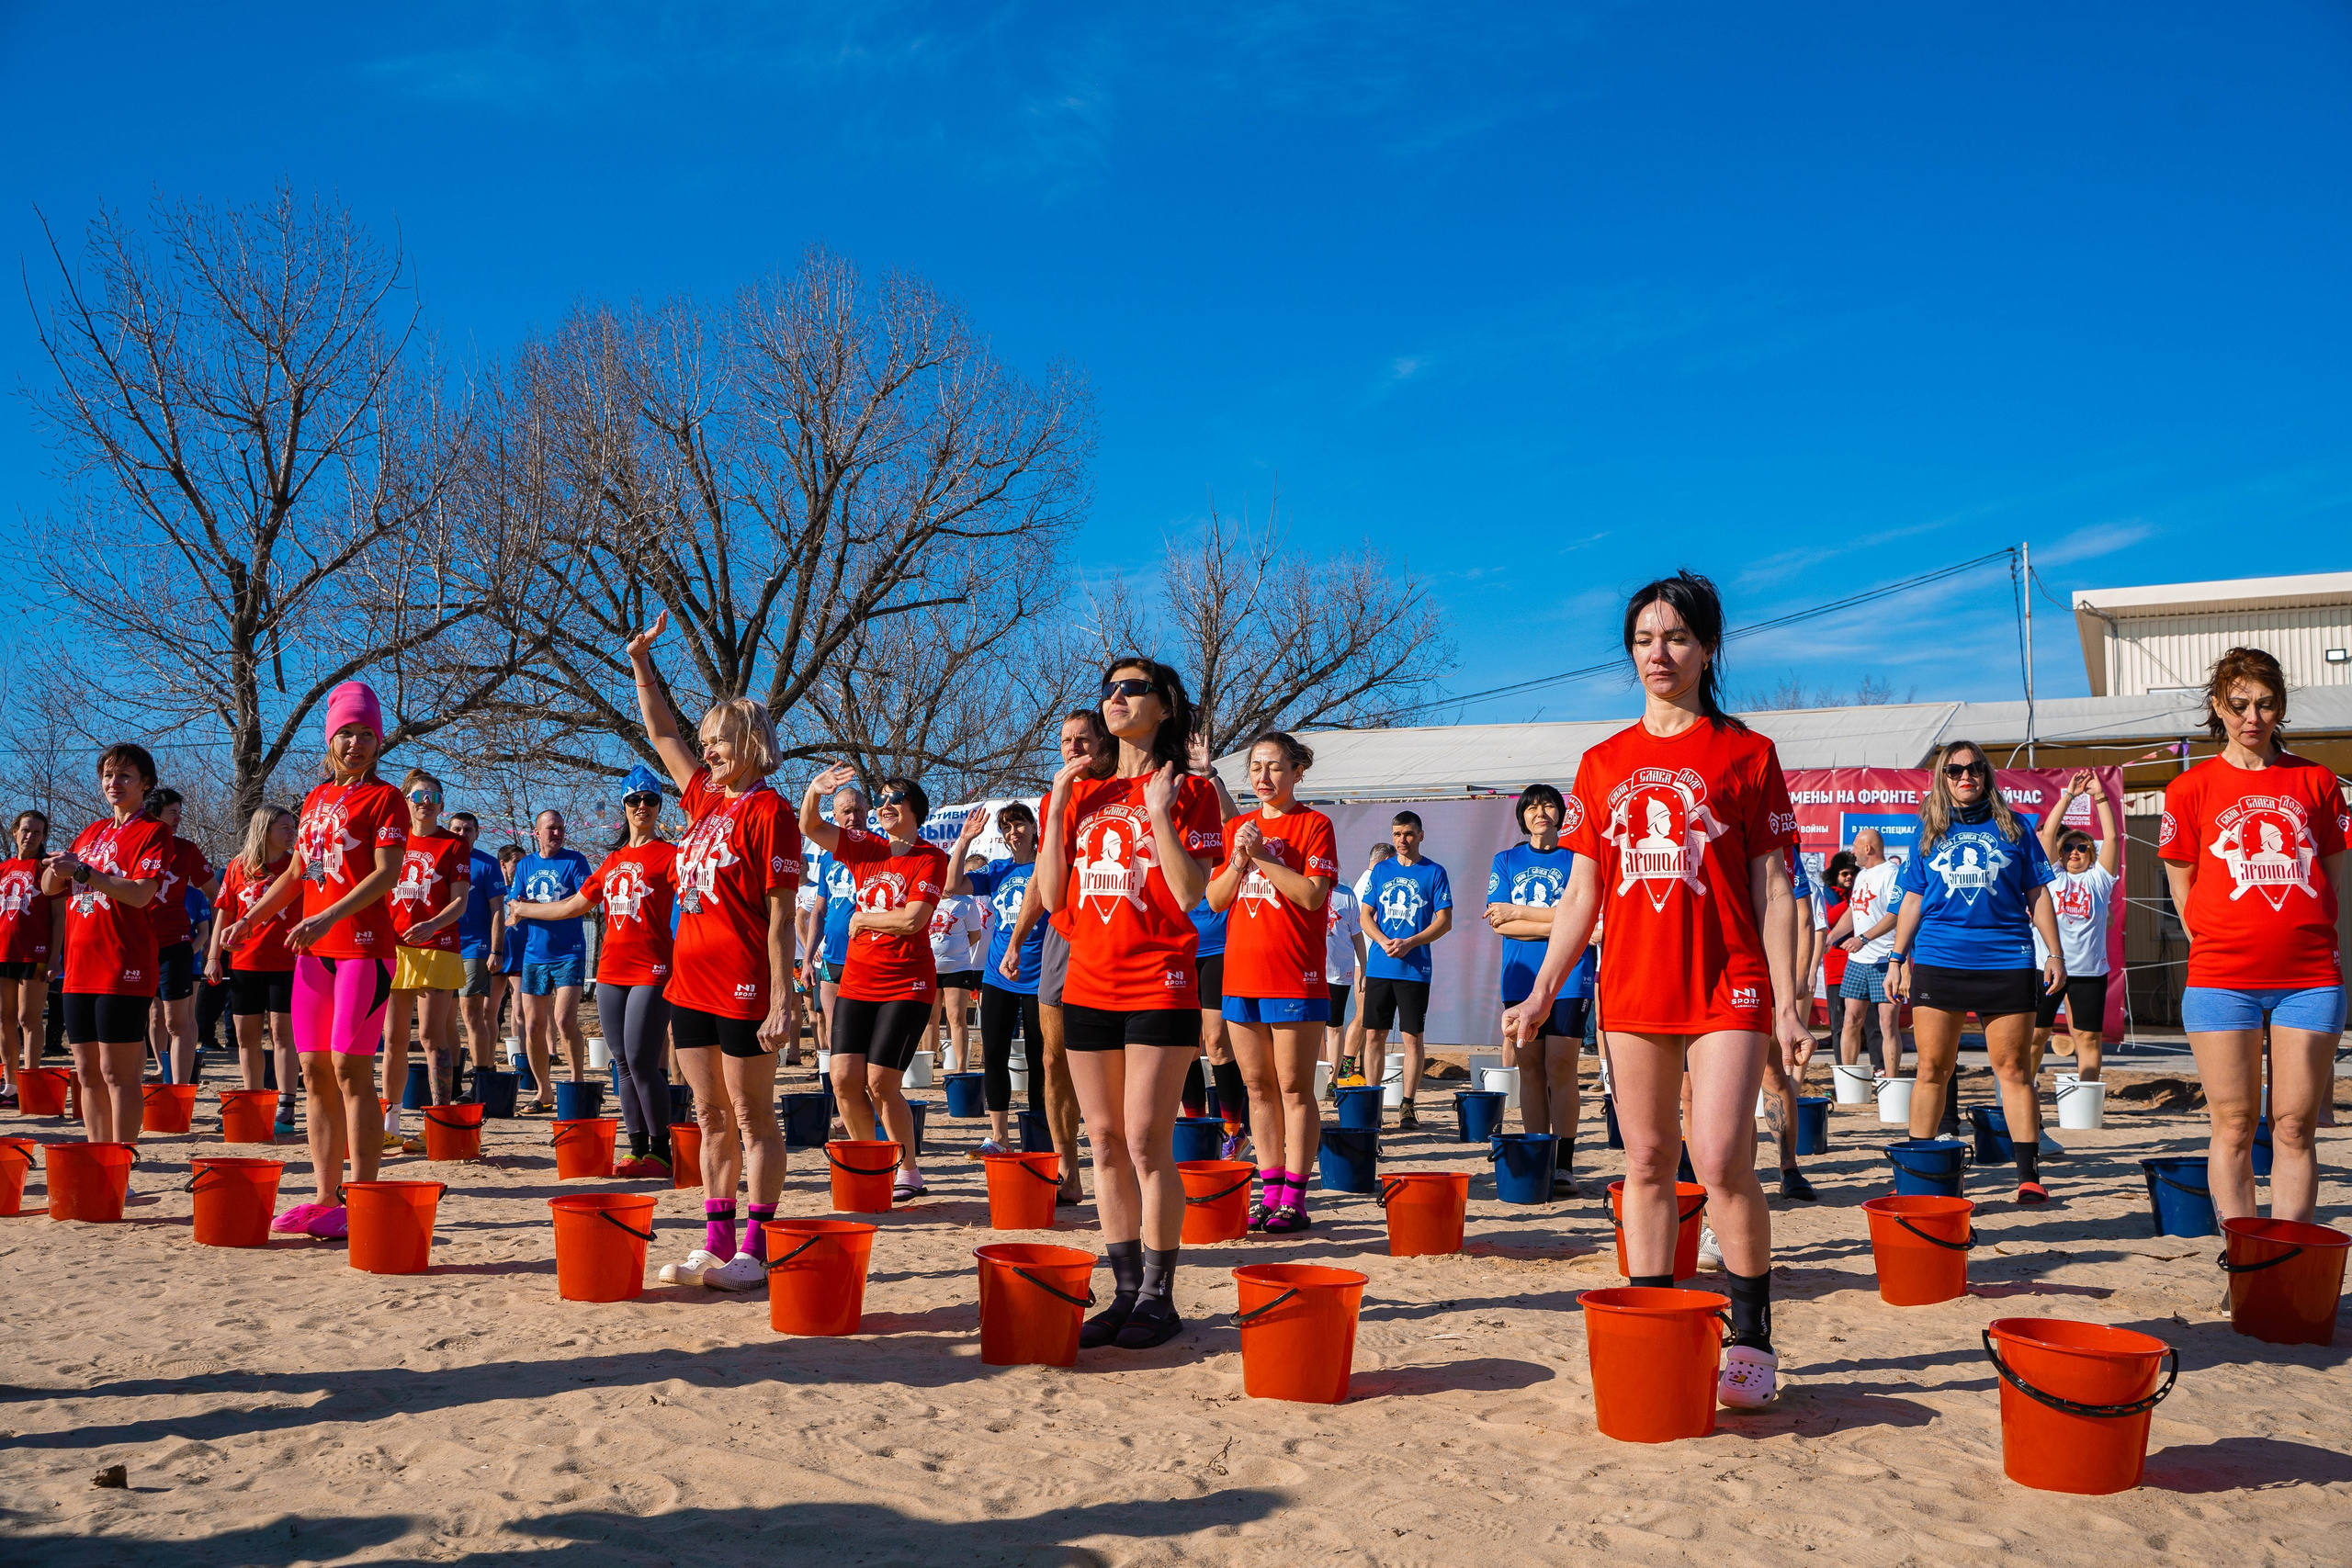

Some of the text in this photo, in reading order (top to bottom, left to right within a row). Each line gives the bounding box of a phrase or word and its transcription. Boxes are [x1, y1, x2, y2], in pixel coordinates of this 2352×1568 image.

[1640, 770, 1672, 784] СЛАВА
[1788, 790, 1833, 805] МЕНЫ
[1837, 790, 1855, 804] НА
[1858, 790, 1919, 805] ФРОНТЕ.
[2002, 787, 2042, 804] ЙЧАС
[2245, 797, 2276, 809] СЛАВА
[1781, 812, 1794, 822] ПУ
[1801, 824, 1828, 833] ВОЙНЫ
[1881, 826, 1917, 834] СПЕЦИАЛ
[1203, 832, 1221, 840] ПУТ
[1203, 840, 1223, 848] ДОМ
[1625, 848, 1691, 873] ЯРОПОЛК
[783, 867, 801, 875] ДОМО
[2240, 861, 2304, 880] ЯРОПОЛК
[1241, 880, 1272, 895] РОПОЛК
